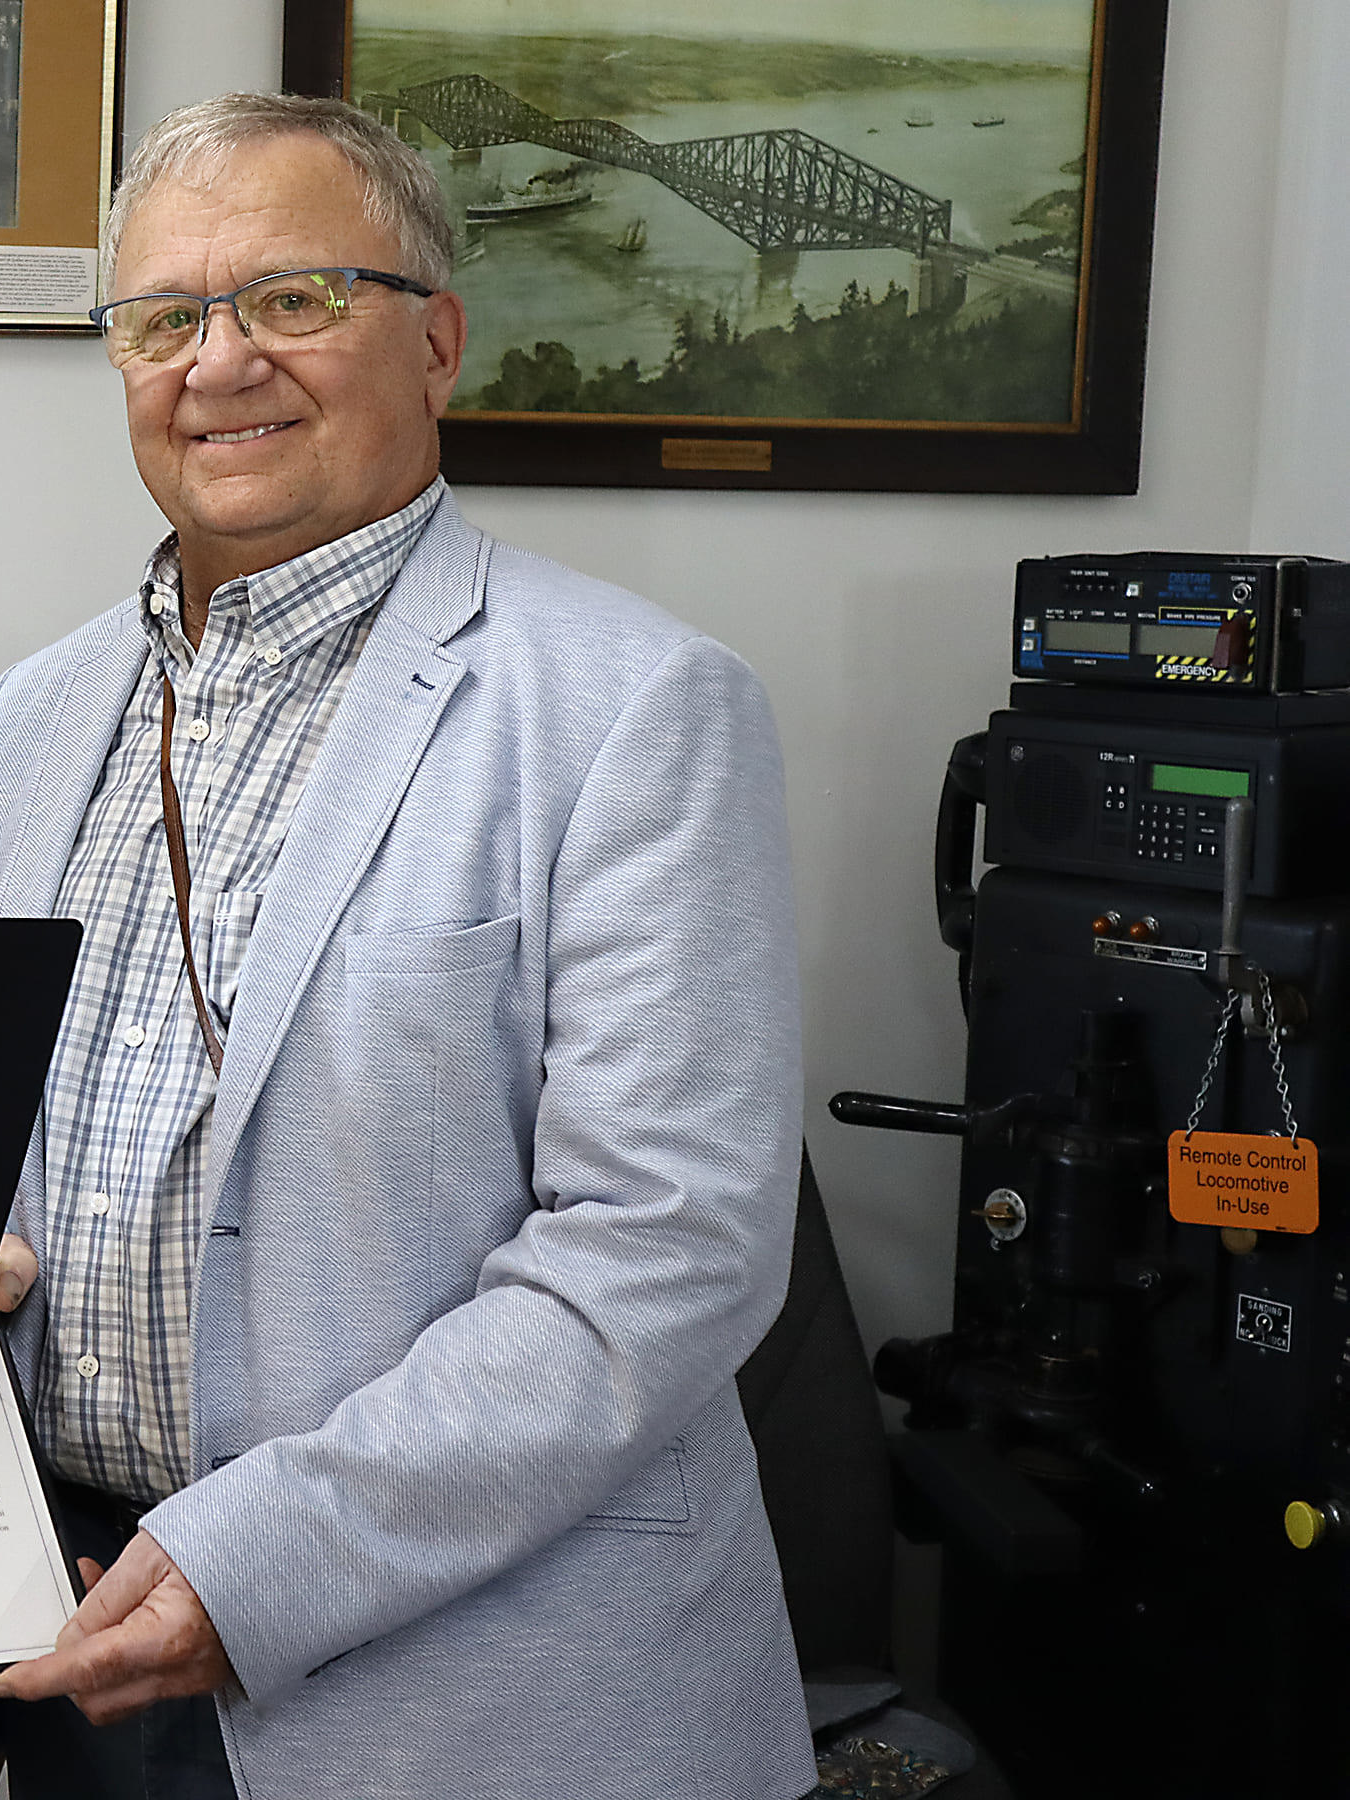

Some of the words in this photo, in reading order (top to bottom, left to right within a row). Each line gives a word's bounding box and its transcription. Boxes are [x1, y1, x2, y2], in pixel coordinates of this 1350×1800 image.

[1162, 664, 1217, 676] EMERGENCY
[1179, 1146, 1241, 1167] Remote
[1247, 1151, 1307, 1172] Control
[1197, 1171, 1289, 1194] Locomotive
[1216, 1195, 1270, 1216] In-Use
[1247, 1300, 1282, 1317] SANDING
